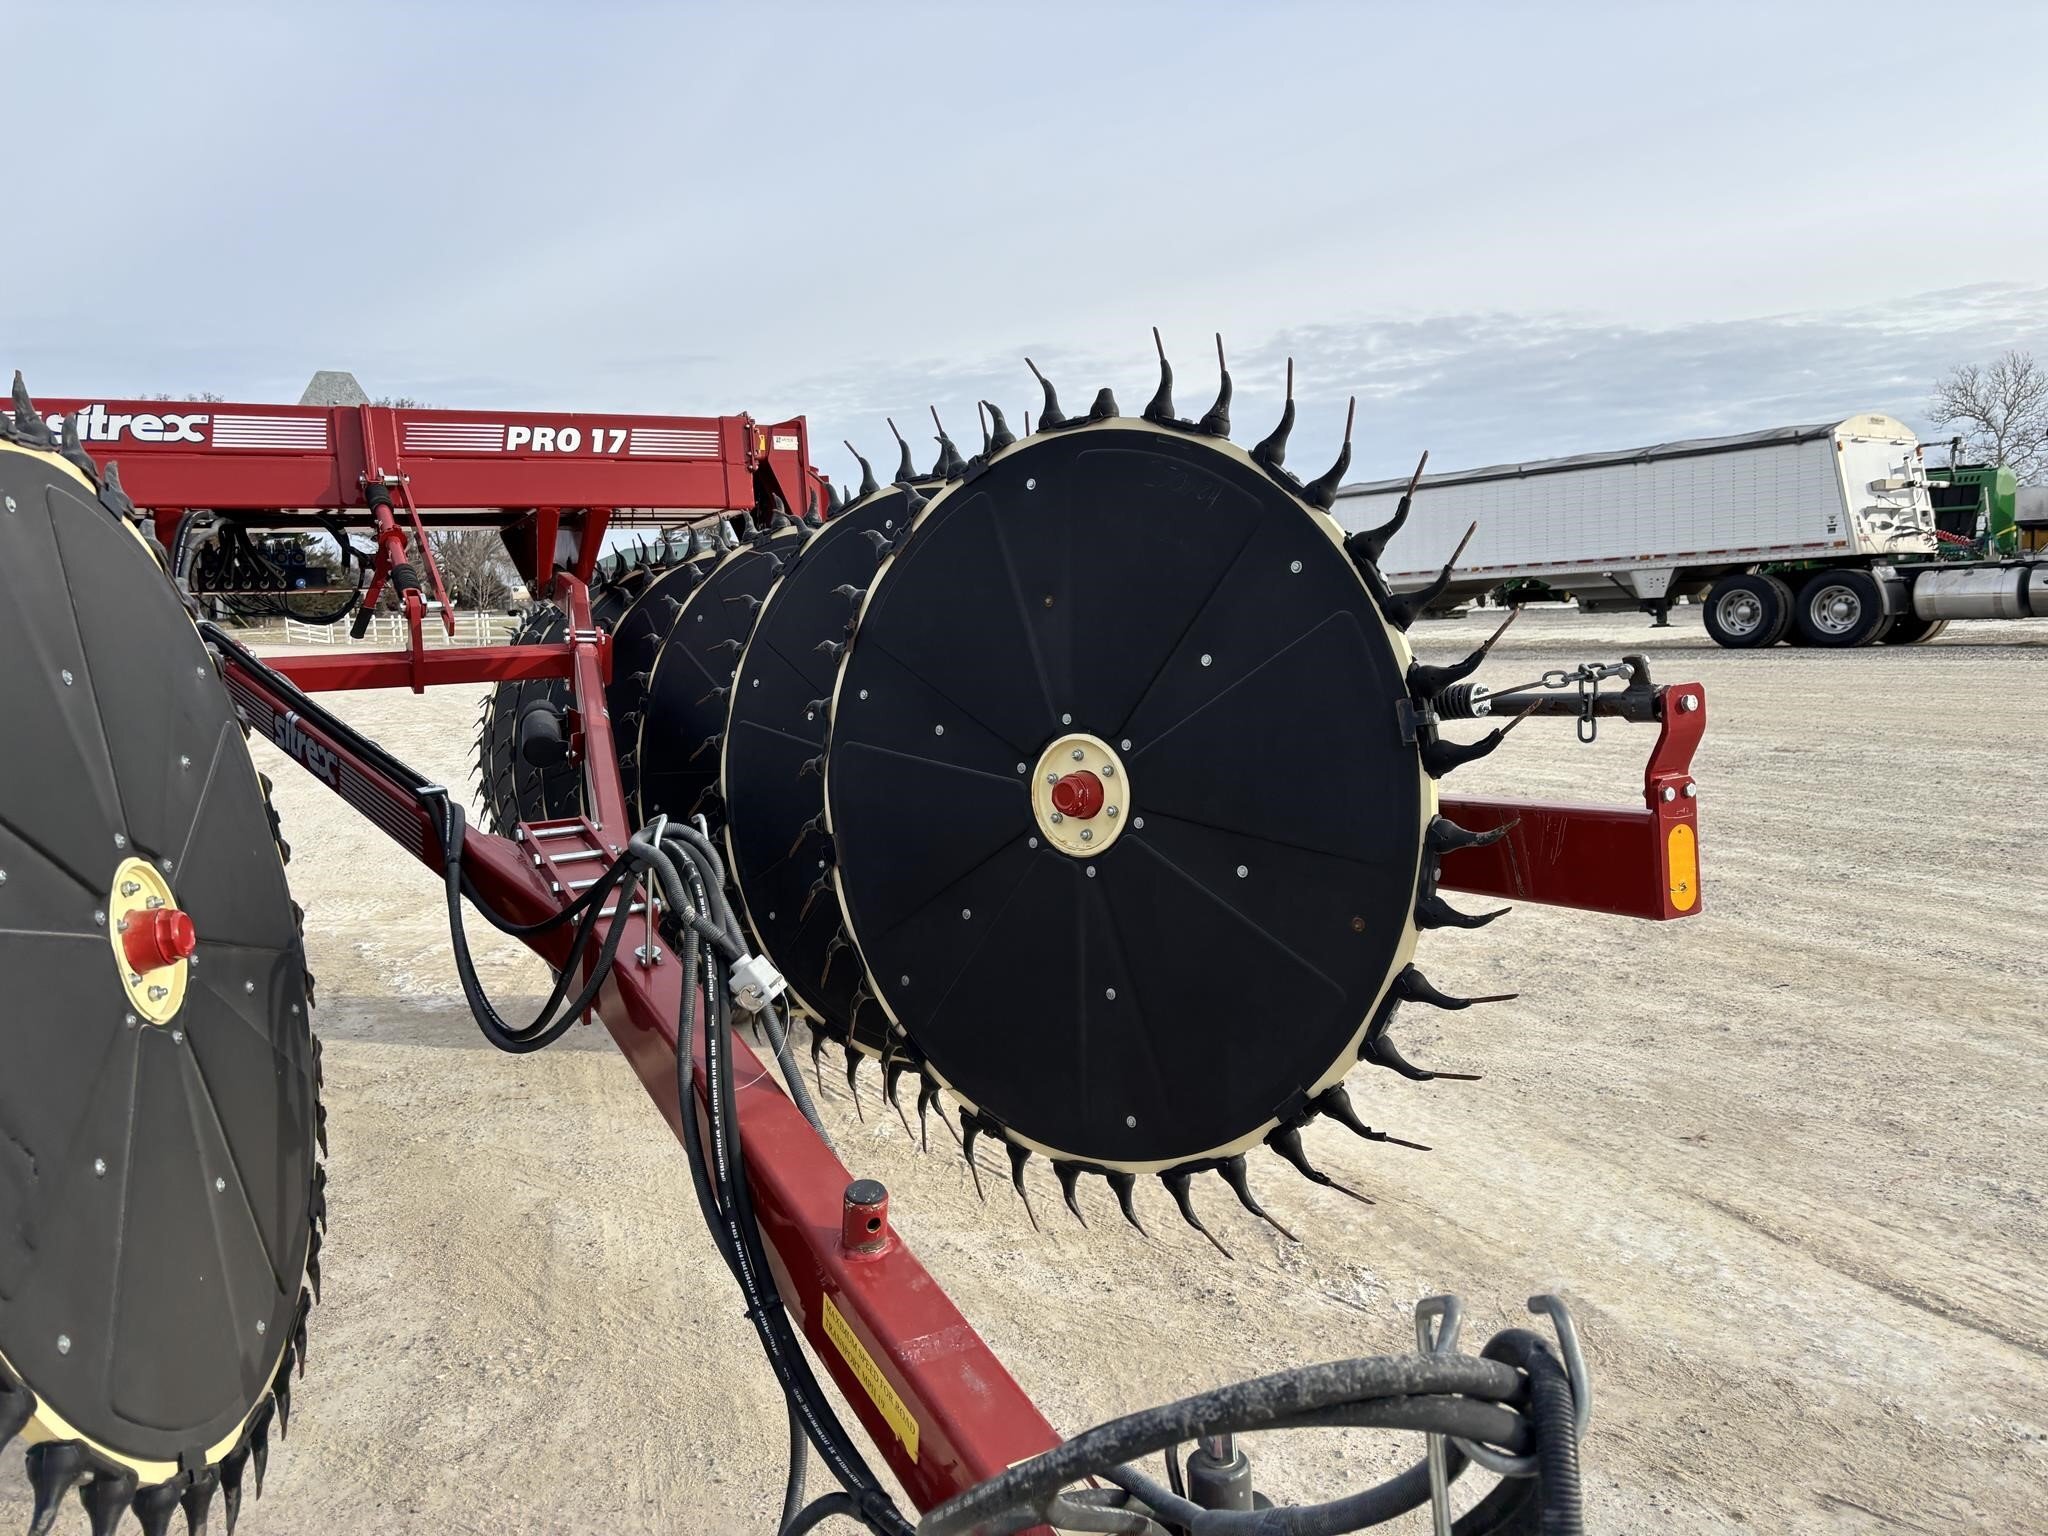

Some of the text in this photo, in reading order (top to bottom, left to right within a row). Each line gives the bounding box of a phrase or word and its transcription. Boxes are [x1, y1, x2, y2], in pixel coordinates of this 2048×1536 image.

[46, 404, 209, 442] sitrex
[506, 426, 627, 453] PRO 17
[274, 711, 338, 785] sitrex
[825, 1316, 860, 1375] TRANSPORT
[862, 1371, 877, 1400] MPH
[825, 1301, 916, 1435] MAXIMUM SPEED FOR ROAD
